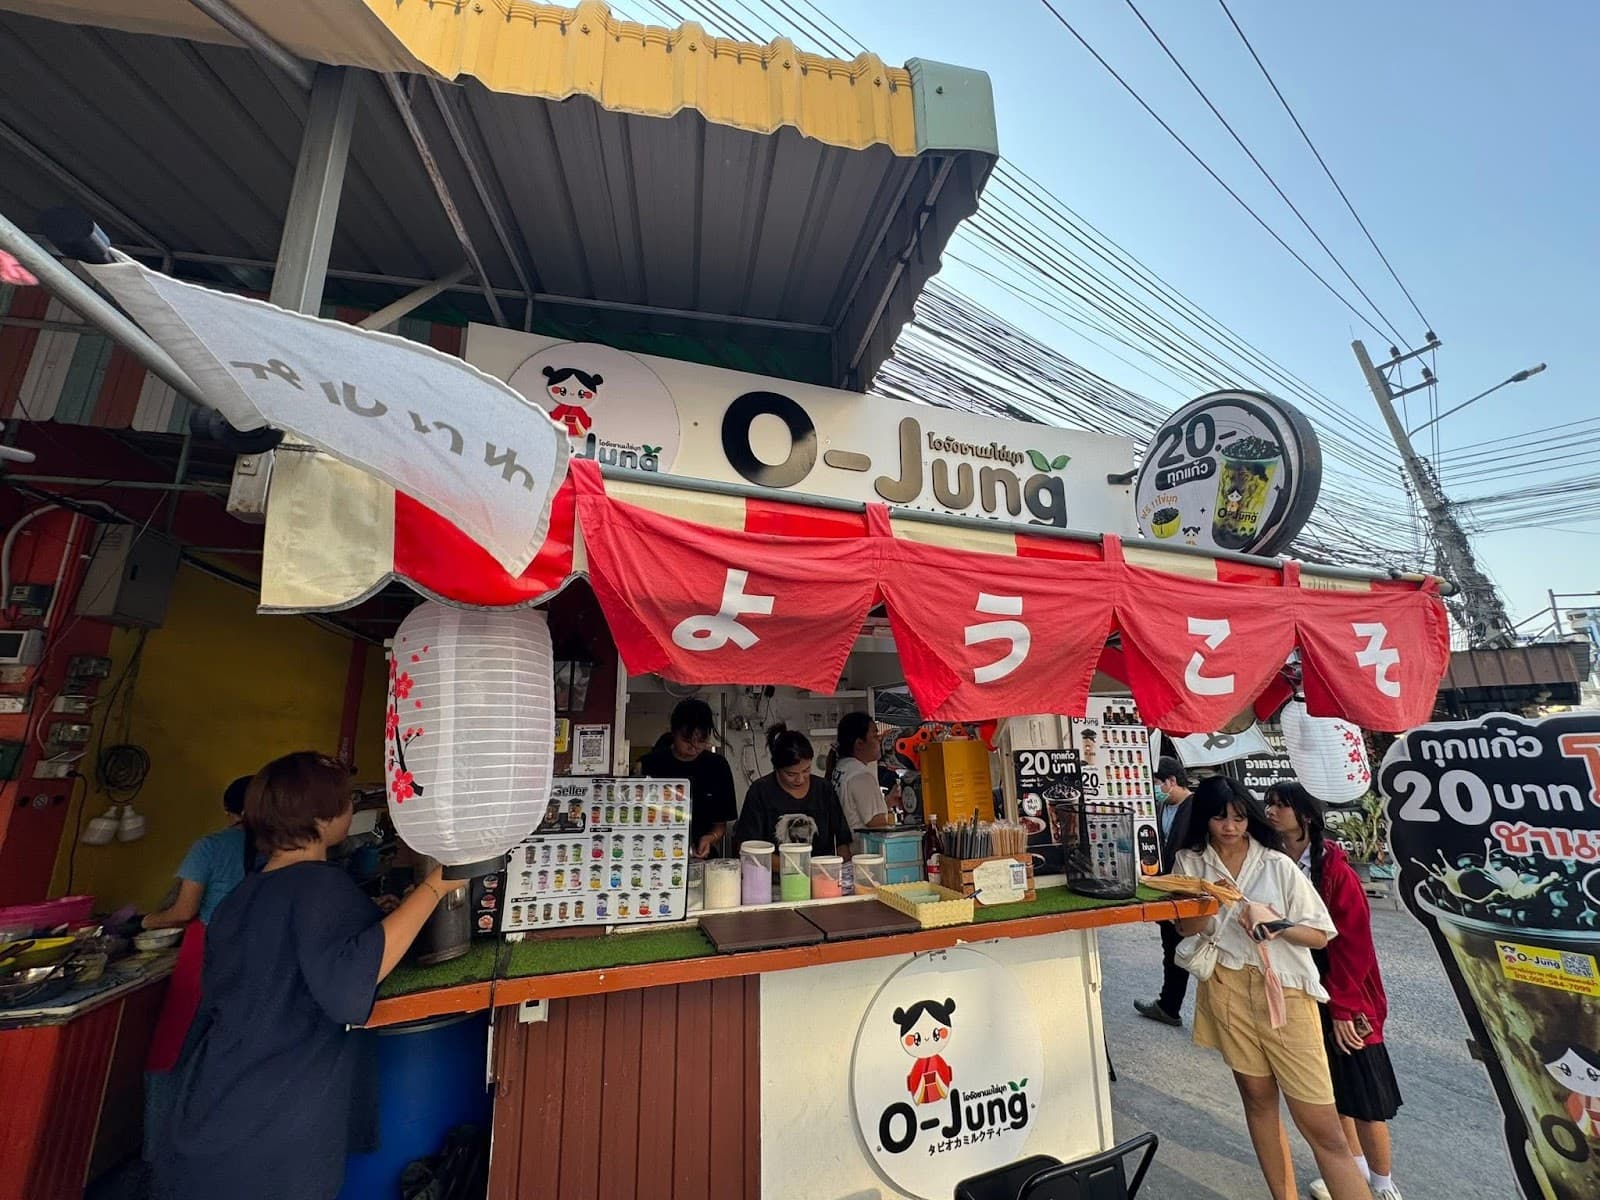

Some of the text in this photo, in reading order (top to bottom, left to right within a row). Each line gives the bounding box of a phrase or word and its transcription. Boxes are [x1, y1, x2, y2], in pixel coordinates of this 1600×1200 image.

[722, 391, 1067, 528] O-Jung
[1166, 461, 1209, 487] ทุกแก้ว
[1019, 752, 1076, 776] 20 บาท
[1420, 727, 1544, 768] ทุกแก้ว
[1393, 769, 1492, 826] 20
[1493, 782, 1584, 812] บาท
[1492, 822, 1600, 861] ชาน
[879, 1089, 1029, 1153] O-Jung
